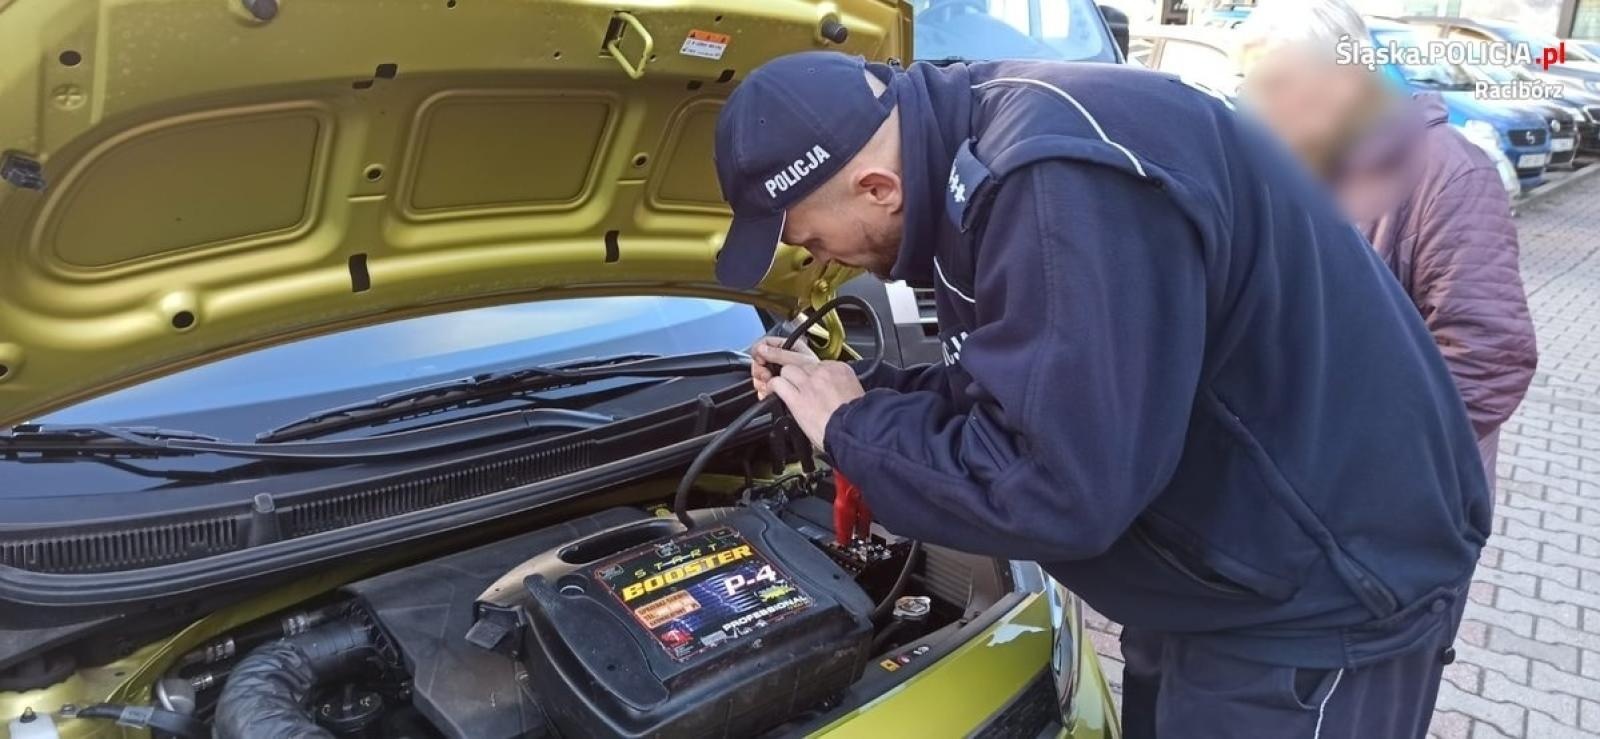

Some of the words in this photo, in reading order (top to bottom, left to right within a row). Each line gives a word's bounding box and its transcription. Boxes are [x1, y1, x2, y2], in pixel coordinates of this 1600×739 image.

[764, 144, 831, 199] POLICJA
[621, 544, 754, 602] BOOSTER
[634, 543, 717, 578] START
[723, 564, 777, 597] P-4
[722, 595, 810, 632] PROFESSIONAL
